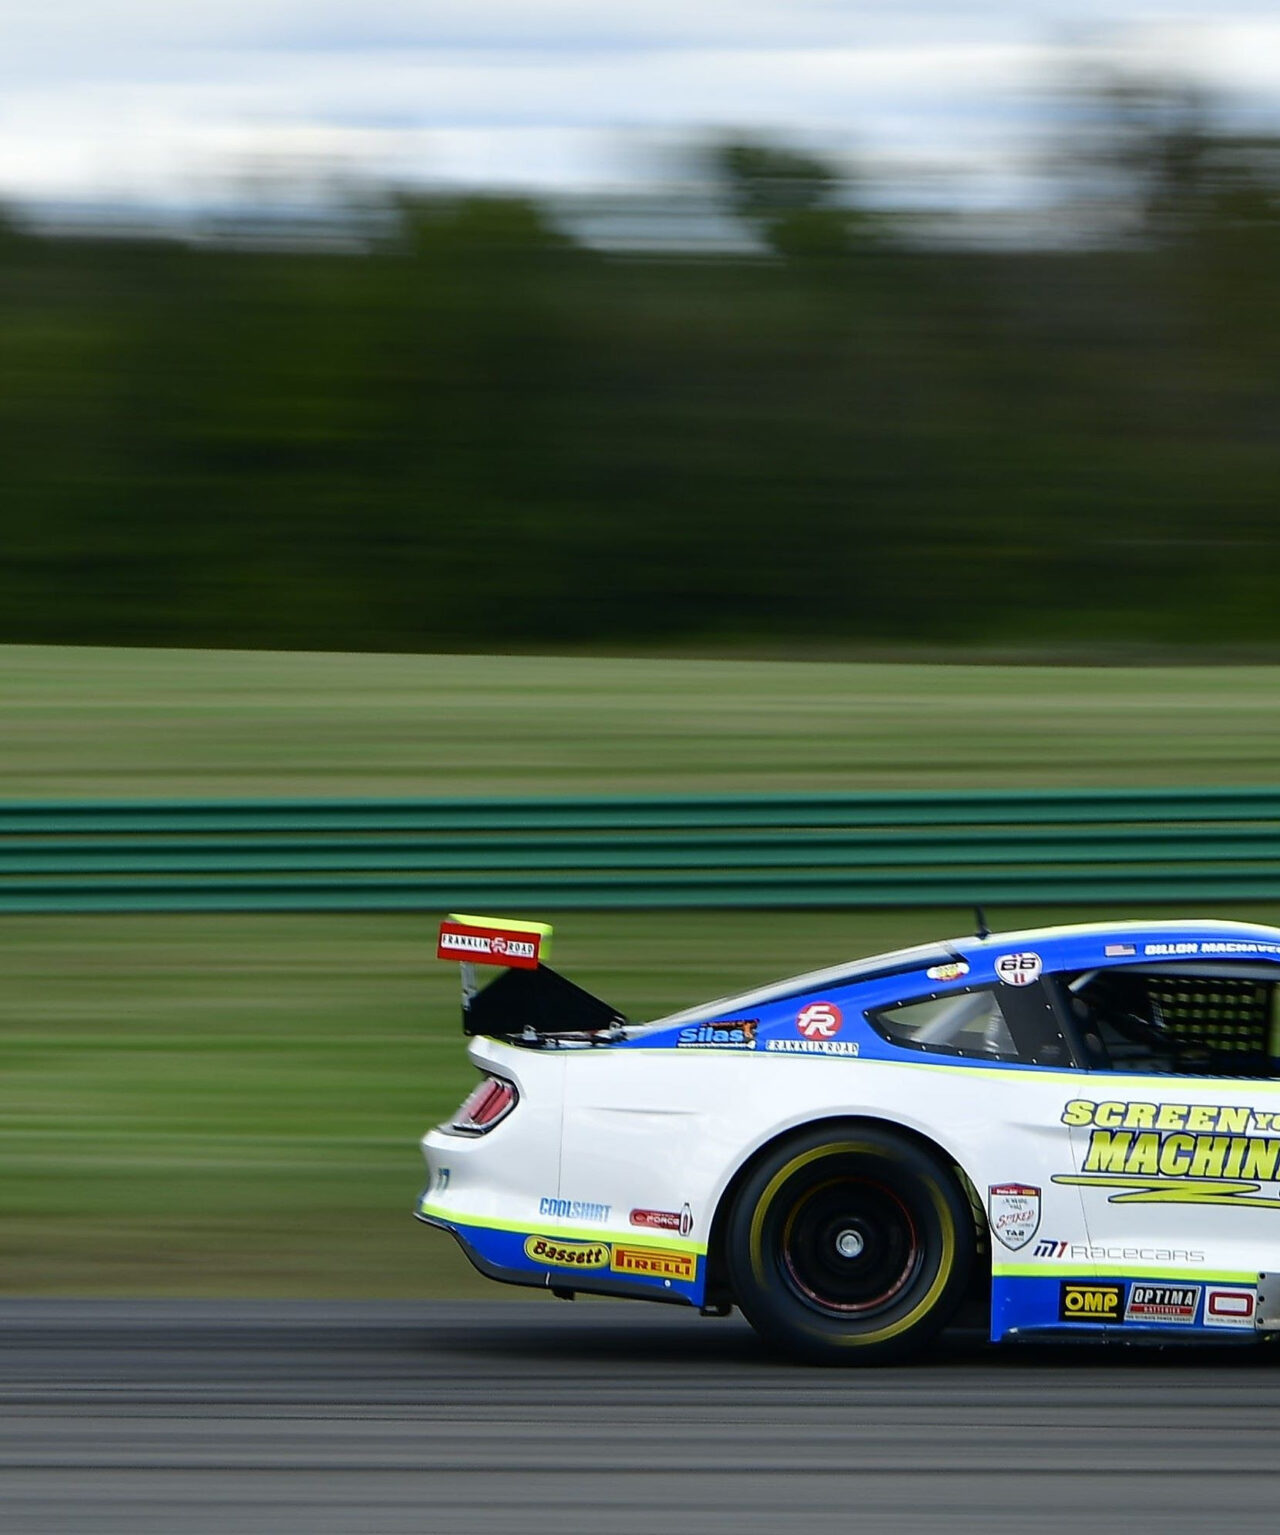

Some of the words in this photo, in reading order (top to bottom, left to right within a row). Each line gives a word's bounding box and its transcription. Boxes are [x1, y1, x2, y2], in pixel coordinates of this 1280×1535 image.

[442, 934, 489, 948] FRANKLIN
[509, 942, 534, 953] ROAD
[1144, 943, 1198, 956] DILLON
[679, 1026, 744, 1043] Silas
[767, 1040, 824, 1051] FRANKLIN
[827, 1042, 859, 1053] ROAD
[1061, 1099, 1254, 1135] SCREEN
[539, 1197, 612, 1223] COOLSHIRT
[533, 1240, 602, 1264] Bassett
[615, 1249, 692, 1276] PIRELLI
[1065, 1291, 1118, 1312] OMP
[1134, 1288, 1194, 1306] OPTIMA
